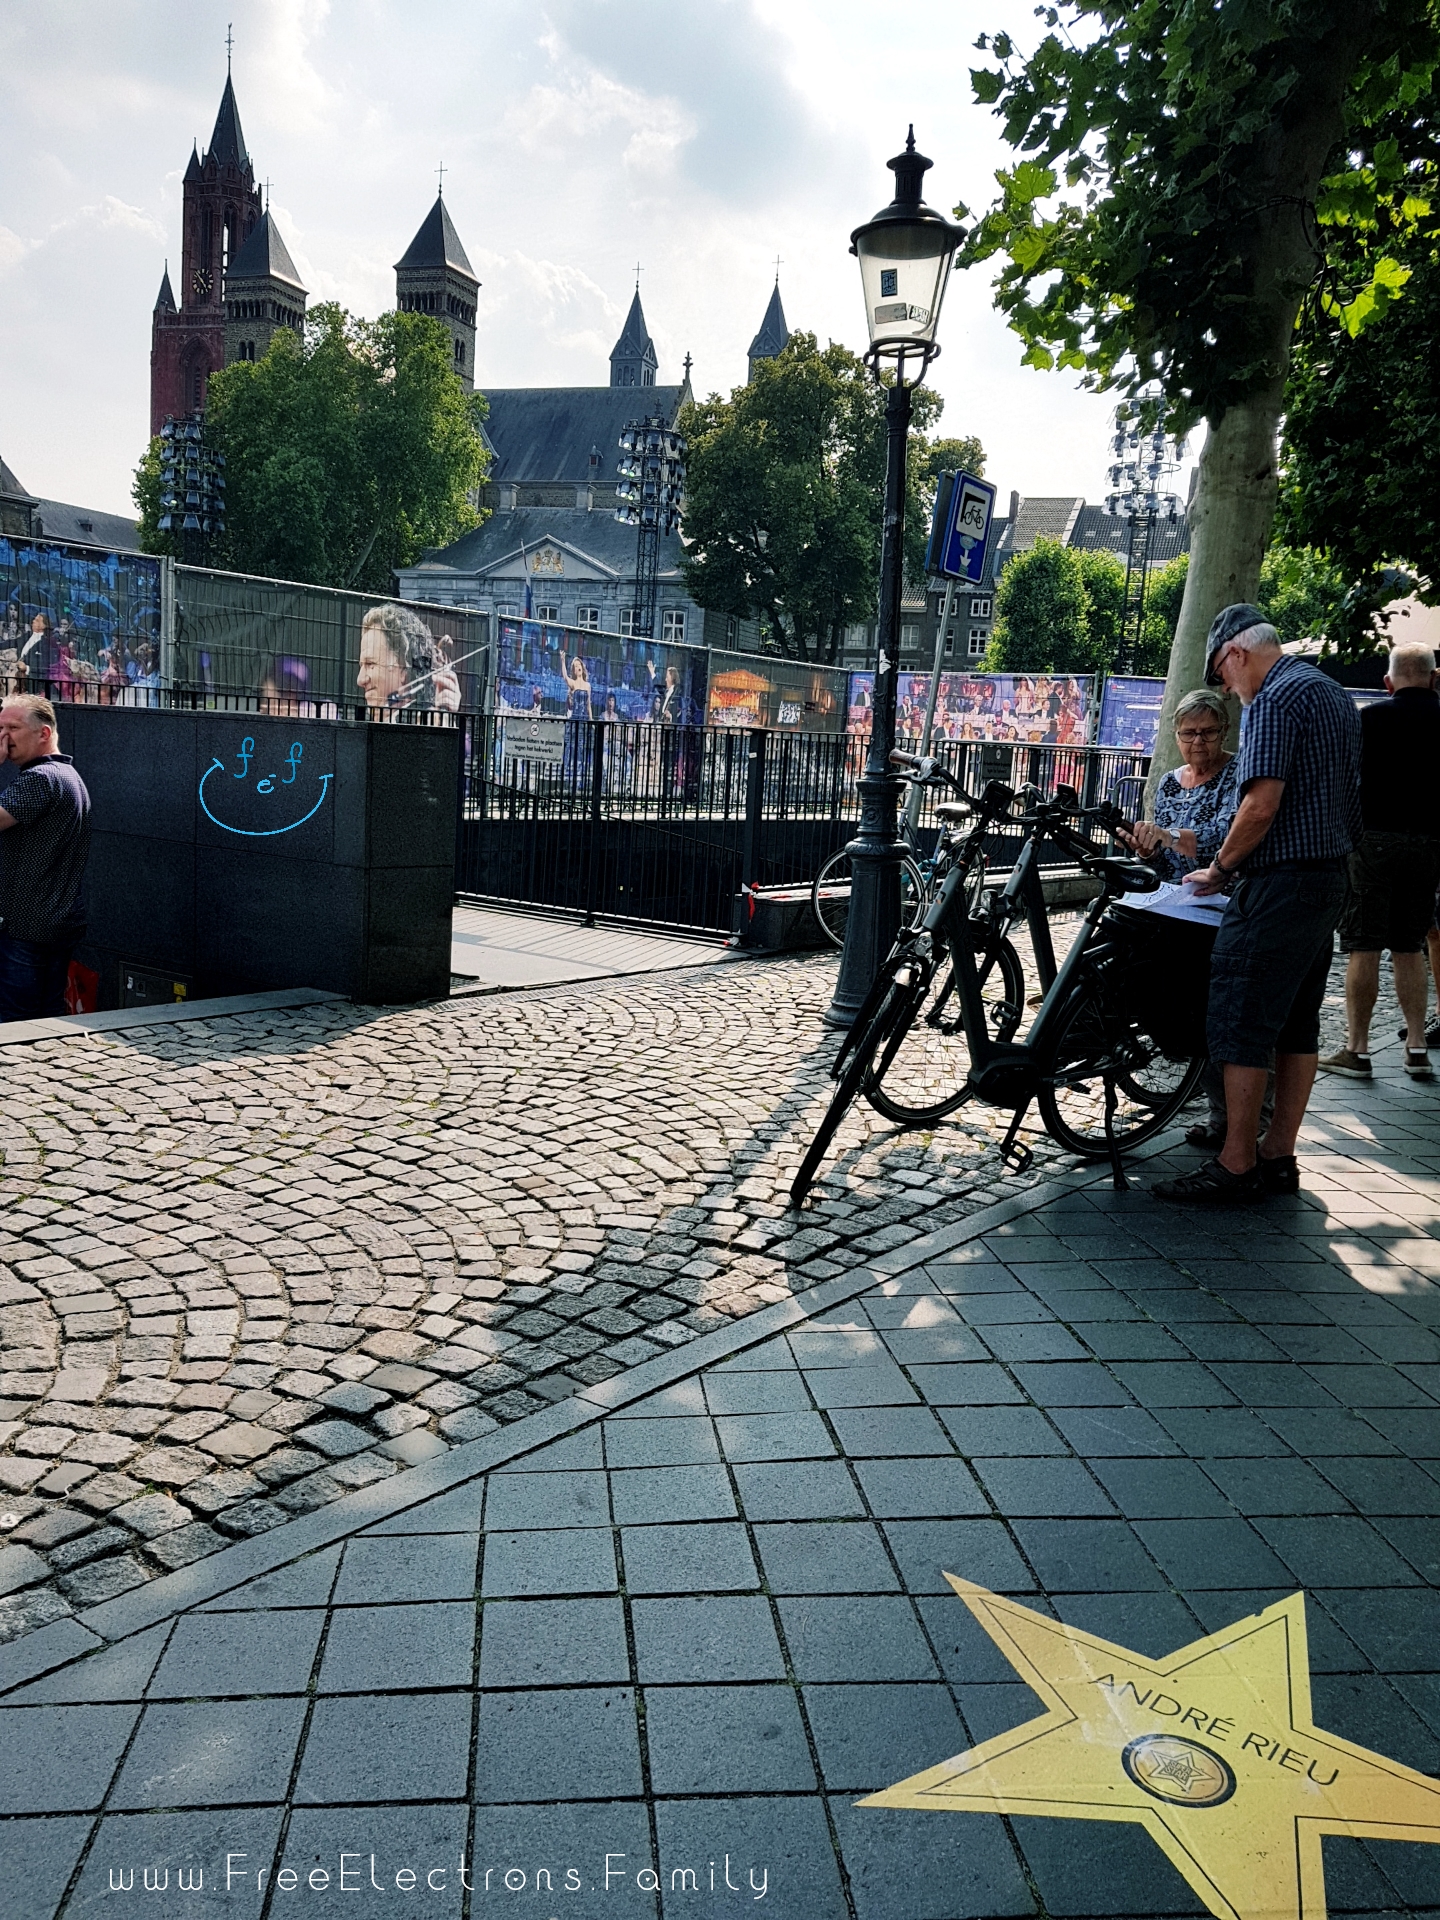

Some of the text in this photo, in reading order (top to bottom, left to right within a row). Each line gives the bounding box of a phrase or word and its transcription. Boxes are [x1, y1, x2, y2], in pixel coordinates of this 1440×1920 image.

[1087, 1673, 1340, 1786] ANDRÉ RIEU
[1165, 1766, 1188, 1780] STAR
[1169, 1760, 1191, 1774] SUPER
